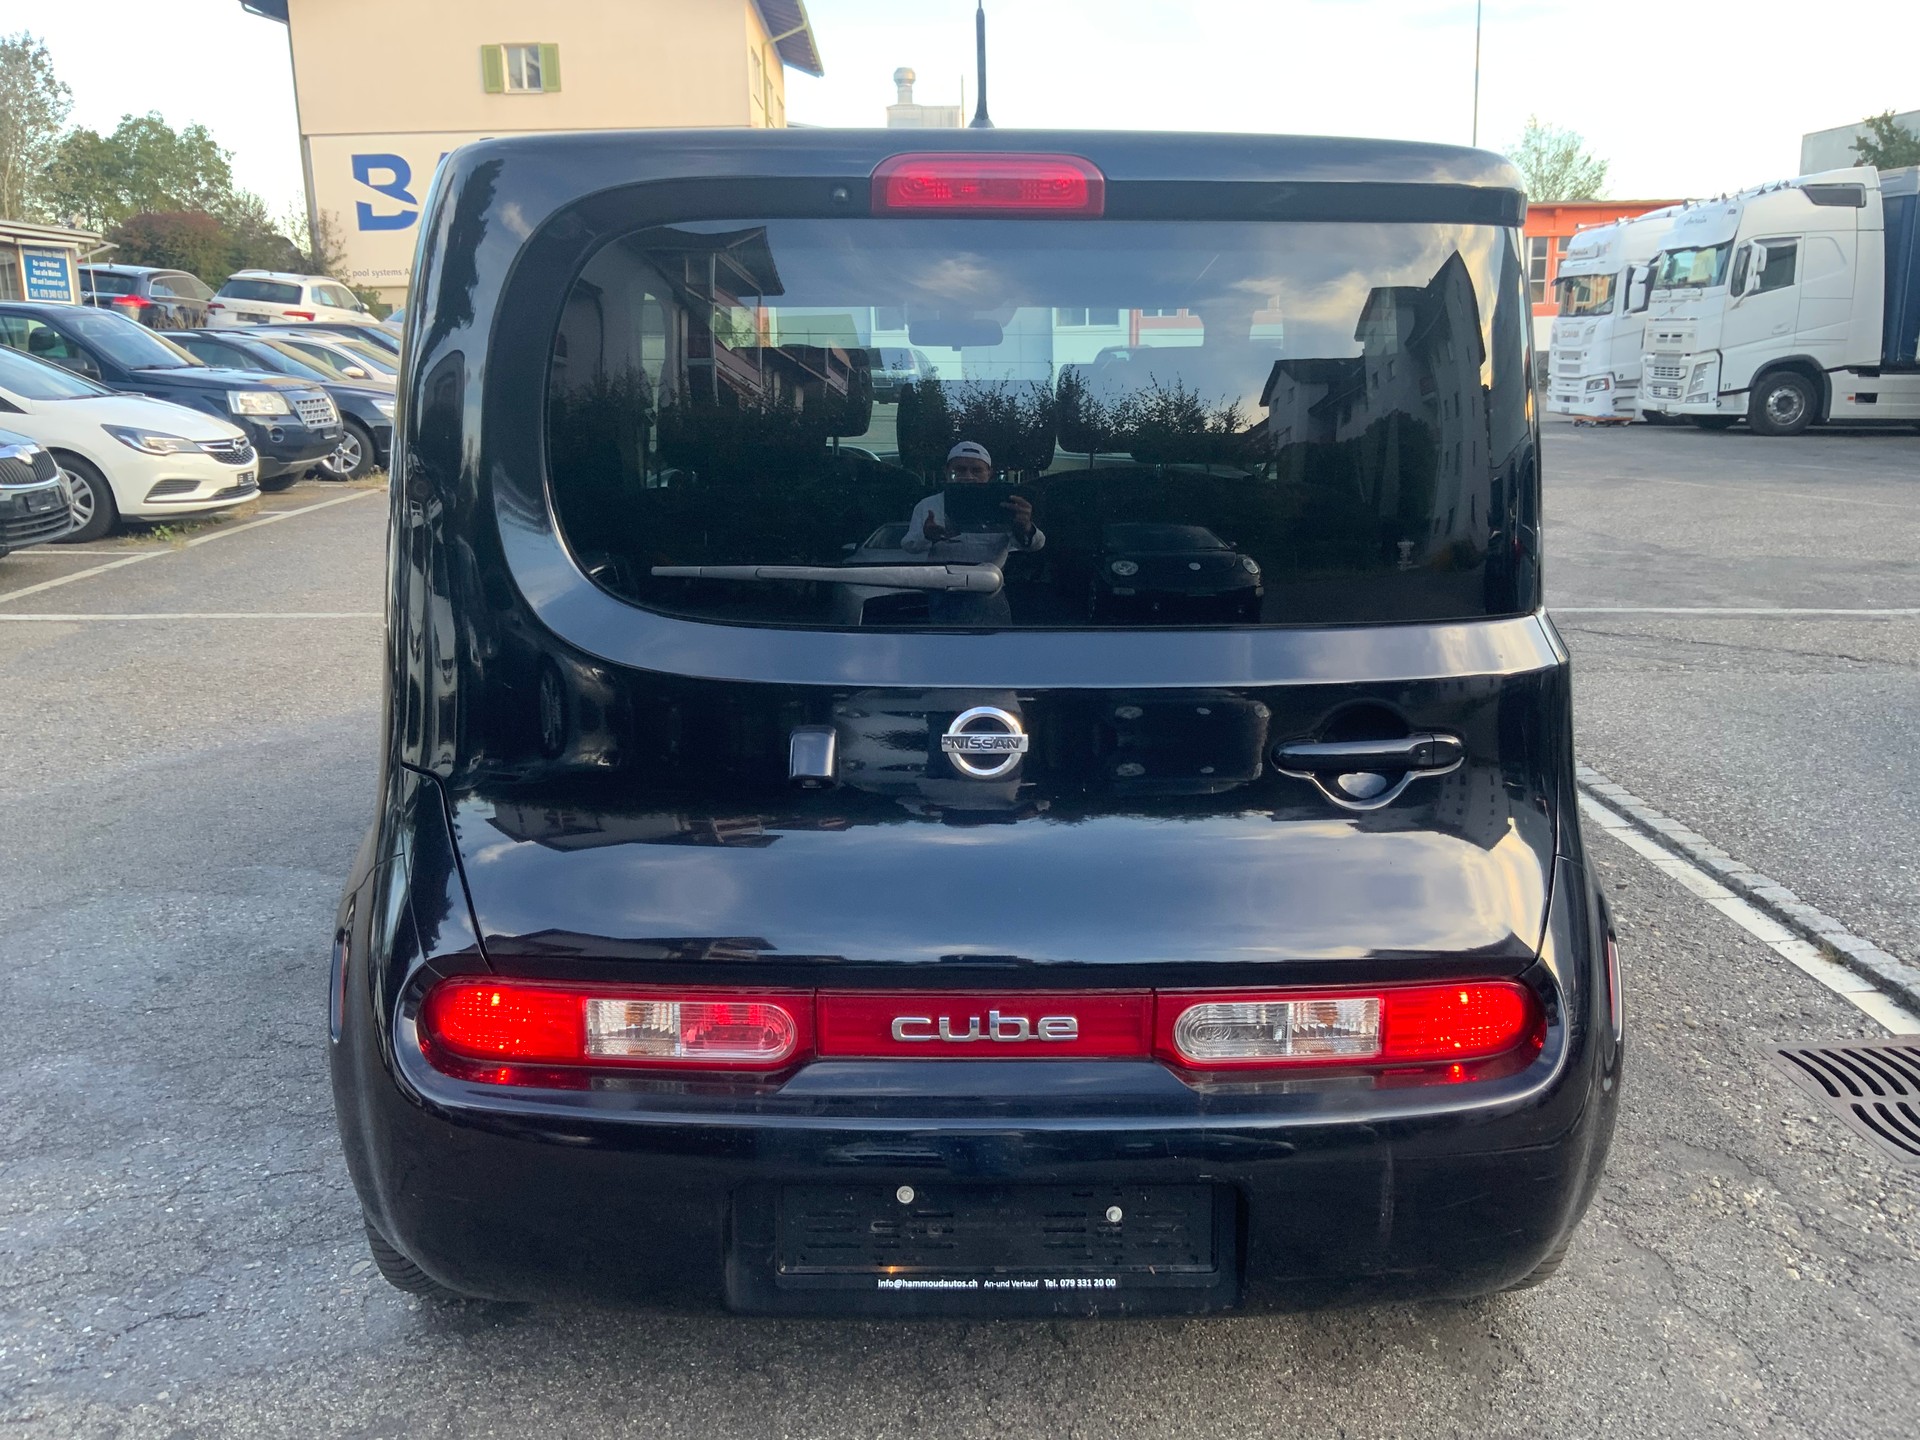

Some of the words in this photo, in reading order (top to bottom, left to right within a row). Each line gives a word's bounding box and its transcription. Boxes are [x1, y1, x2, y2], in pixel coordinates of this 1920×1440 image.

[352, 268, 369, 277] pool
[371, 268, 402, 278] systems
[951, 736, 1019, 750] NISSAN
[891, 1010, 1078, 1042] cube
[877, 1279, 978, 1289] info@hammoudautos.ch
[983, 1280, 1010, 1288] An-und
[1011, 1280, 1039, 1288] Verkauf
[1043, 1279, 1059, 1288] Tel.
[1059, 1279, 1075, 1288] 079
[1076, 1279, 1092, 1288] 331
[1093, 1279, 1105, 1288] 20
[1105, 1279, 1117, 1288] 00
